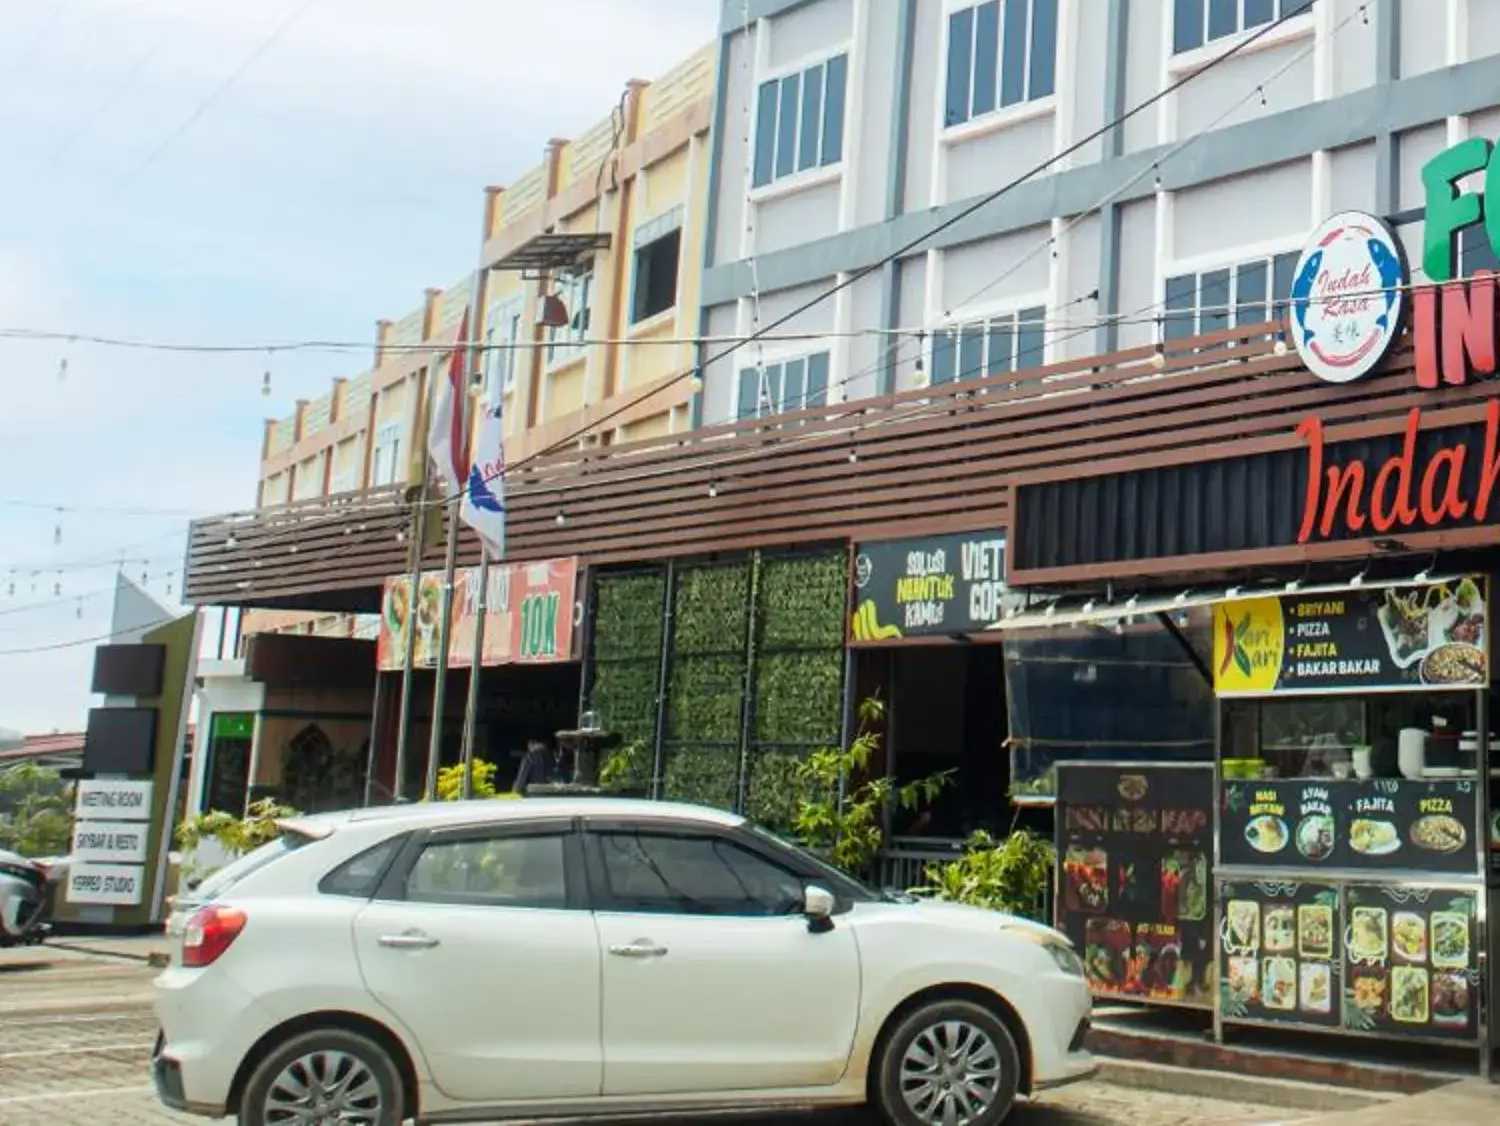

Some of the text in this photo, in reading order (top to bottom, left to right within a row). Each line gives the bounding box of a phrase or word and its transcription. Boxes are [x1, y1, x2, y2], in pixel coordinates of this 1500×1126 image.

[1317, 263, 1371, 295] Indah
[1321, 294, 1369, 320] Rasa
[961, 538, 1008, 581] VIET
[1297, 601, 1344, 617] BRIYANI
[1297, 622, 1330, 637] PIZZA
[1297, 643, 1338, 658] FAJITA
[1297, 660, 1380, 676] BAKAR BAKAR
[1356, 797, 1394, 812] FAJITA
[1420, 799, 1453, 812] PIZZA
